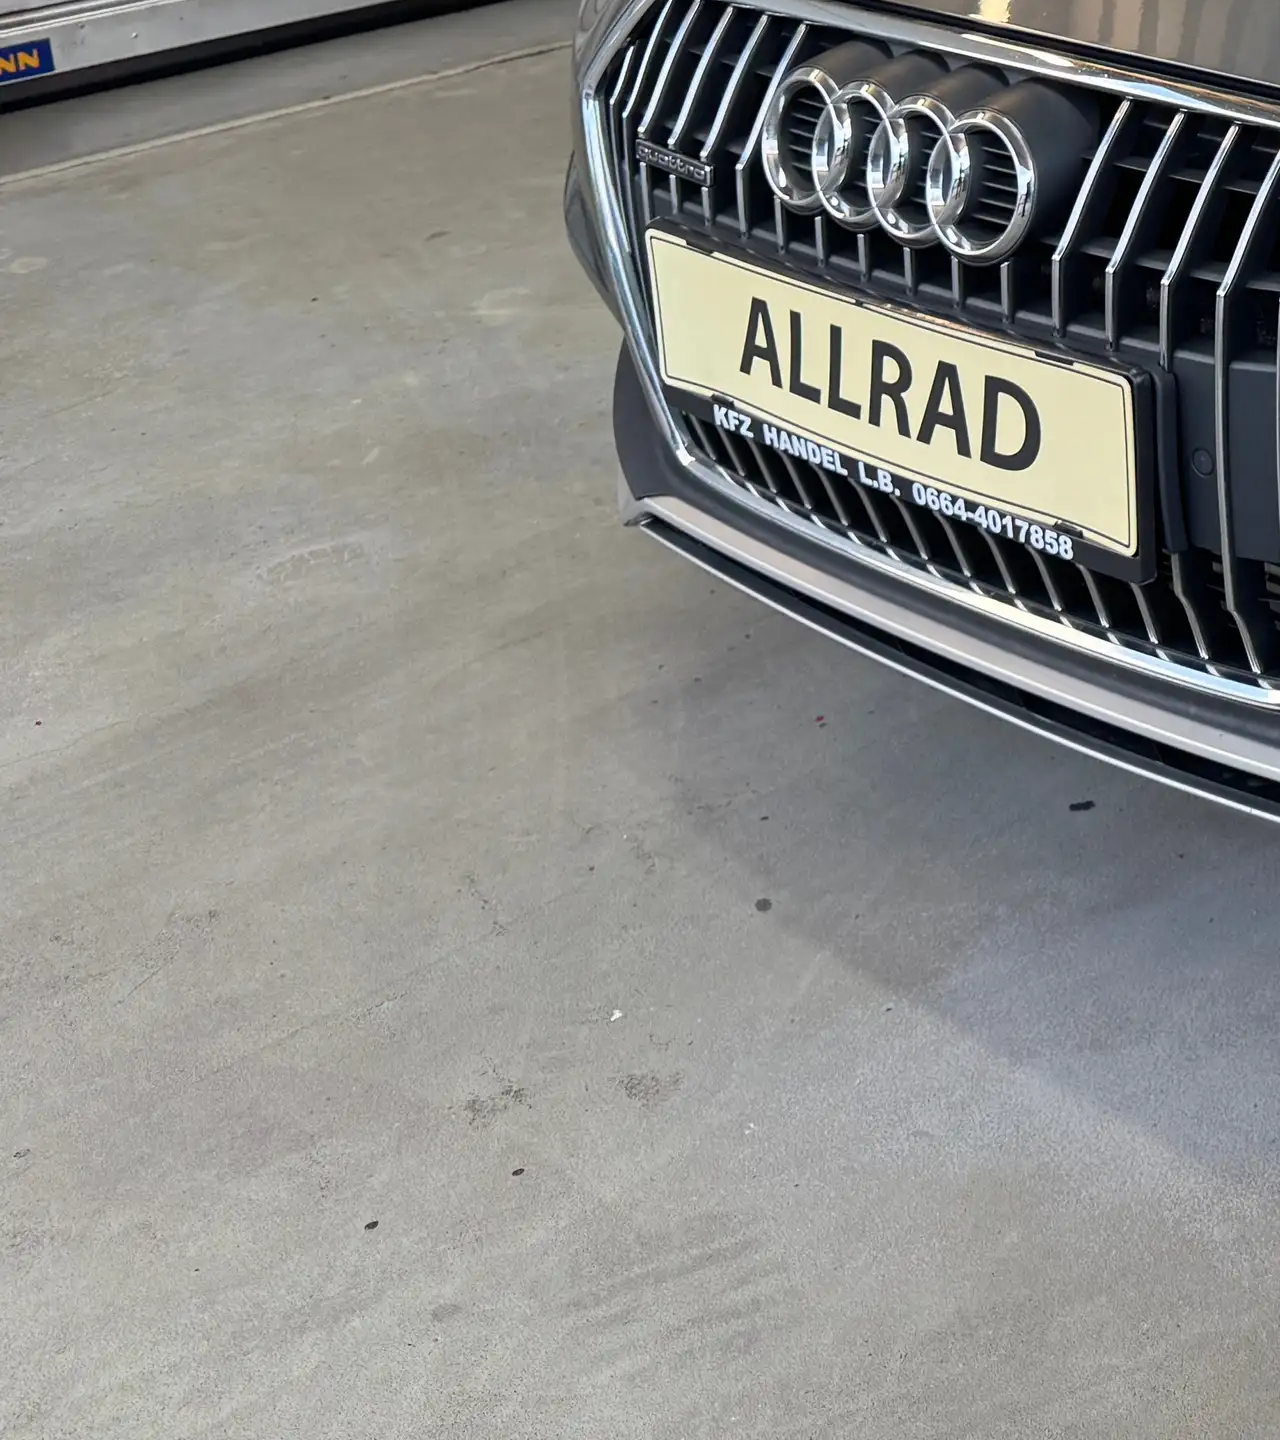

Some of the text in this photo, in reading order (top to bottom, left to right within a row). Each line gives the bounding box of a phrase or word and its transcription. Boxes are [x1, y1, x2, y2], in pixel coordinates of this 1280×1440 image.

[739, 296, 1042, 471] ALLRAD
[713, 404, 1074, 561] KFZ HANDEL L.B. 0664-4017858
